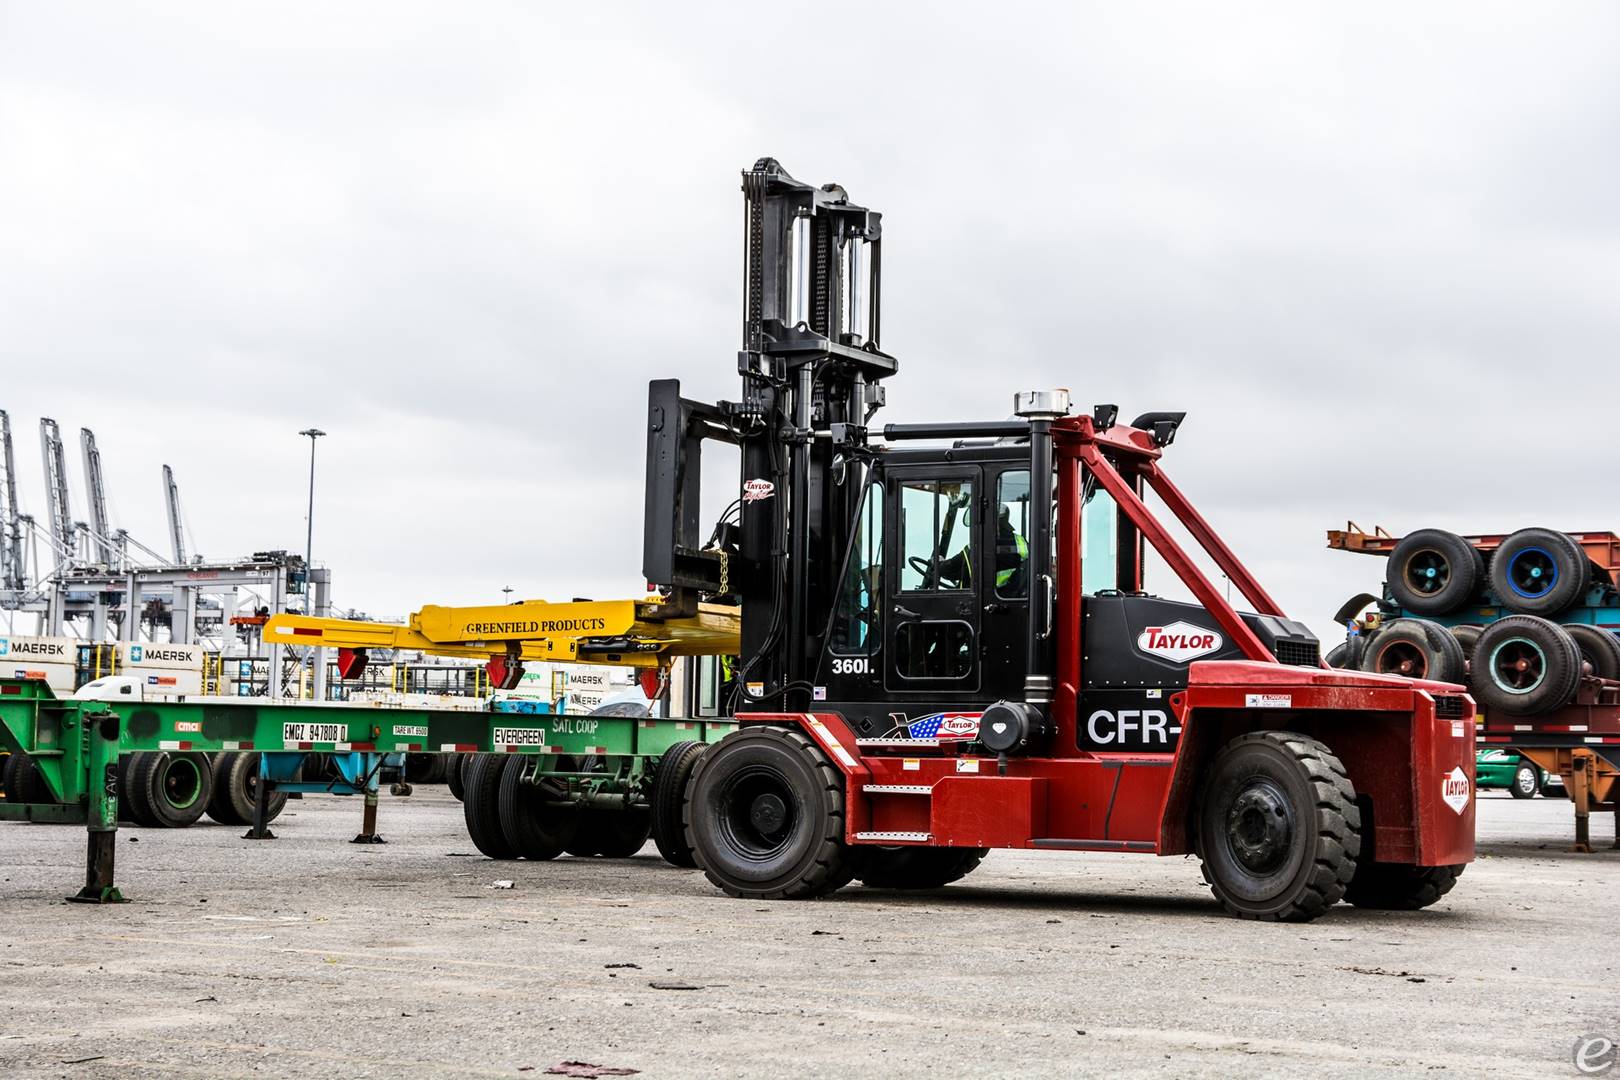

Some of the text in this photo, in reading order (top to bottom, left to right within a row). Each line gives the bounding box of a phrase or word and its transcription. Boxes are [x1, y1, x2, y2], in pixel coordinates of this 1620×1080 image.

[747, 481, 771, 490] TAYLOR
[467, 618, 605, 634] GREENFIELD PRODUCTS
[1146, 628, 1214, 649] TAYLOR
[11, 642, 64, 655] MAERSK
[145, 650, 192, 662] MAERSK
[570, 675, 603, 685] MAERSK
[576, 719, 599, 734] COOP
[947, 720, 973, 729] TAYLOR
[1087, 709, 1182, 744] CFR-
[284, 723, 346, 742] EMCZ 947808 0
[495, 728, 544, 744] EVERGREEN
[1442, 773, 1468, 796] TAYLOR
